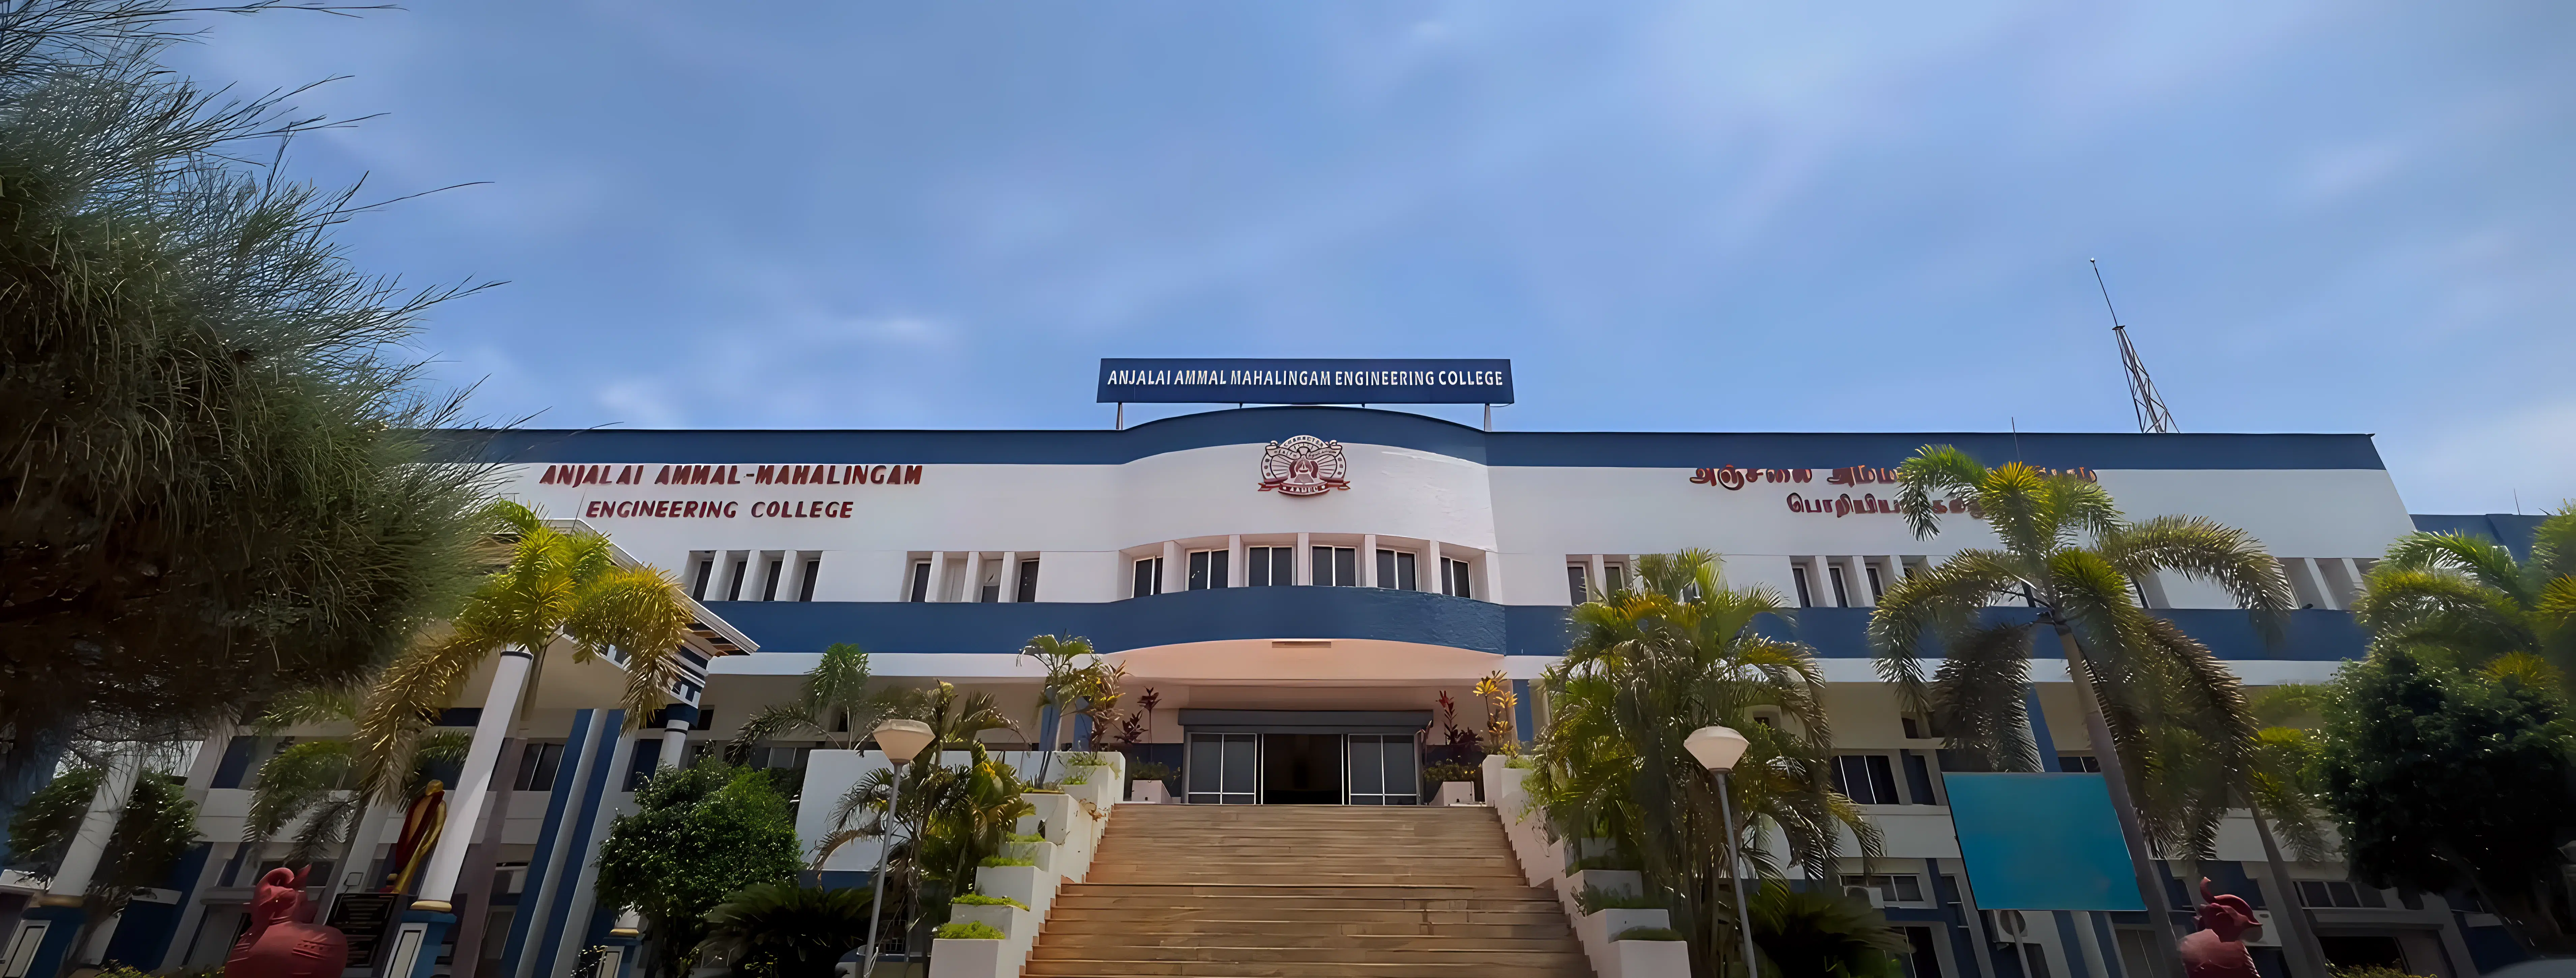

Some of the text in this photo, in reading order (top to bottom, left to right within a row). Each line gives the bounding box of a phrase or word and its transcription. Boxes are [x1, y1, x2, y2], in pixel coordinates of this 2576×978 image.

[1108, 370, 1503, 386] ANJALAI AMMAL MAHALINGAM ENGINEERING COLLEGE
[539, 465, 644, 488] ANJALAI
[586, 500, 854, 518] ENGINEERING COLLEGE
